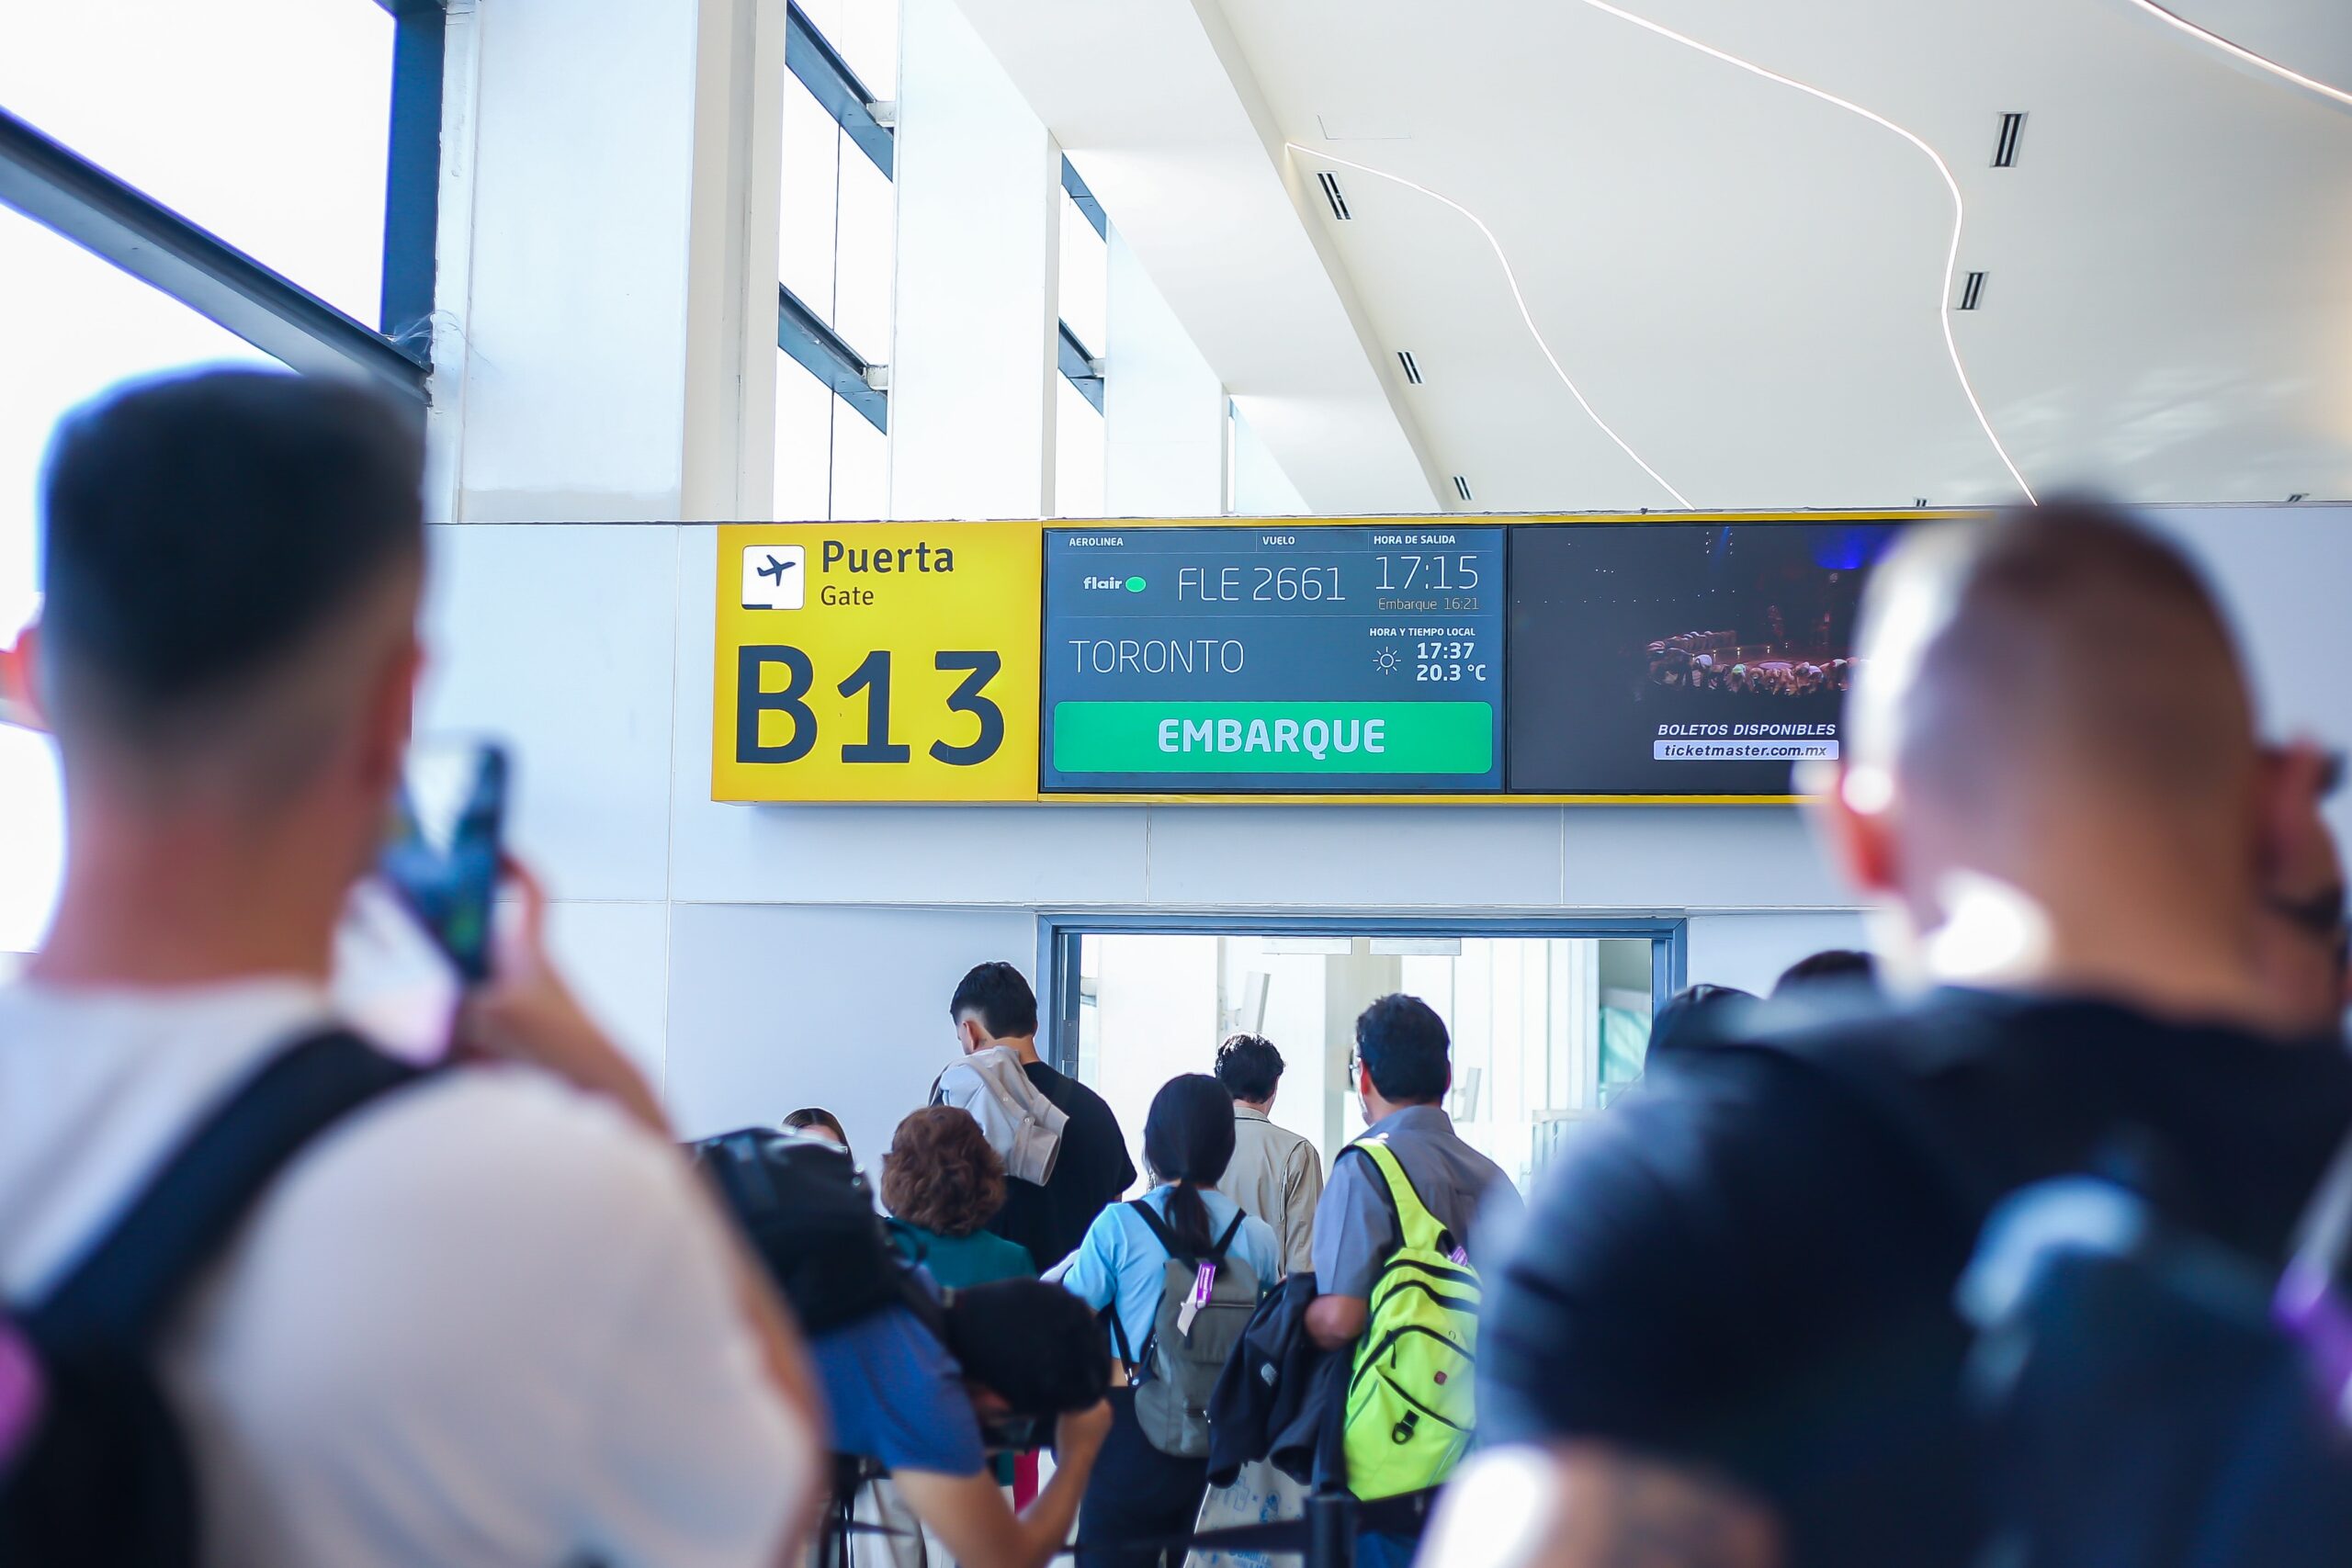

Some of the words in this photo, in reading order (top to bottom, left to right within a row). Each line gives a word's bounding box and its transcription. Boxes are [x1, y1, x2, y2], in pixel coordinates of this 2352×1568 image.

[1069, 537, 1124, 547] AEROLINEA
[1262, 536, 1295, 546] VUELO
[1374, 536, 1402, 545] HORA
[1406, 536, 1418, 544] DE
[1420, 535, 1456, 544] SALIDA
[822, 540, 954, 573] Puerta
[1375, 555, 1478, 590] 17:15
[1083, 577, 1123, 590] flair
[1179, 568, 1239, 602] FLE
[1253, 567, 1346, 601] 2661
[820, 585, 874, 606] Gate
[1378, 597, 1438, 612] Embarque
[1443, 597, 1479, 610] 16:21
[1369, 627, 1397, 637] HORA
[1399, 627, 1406, 637] Y
[1408, 627, 1444, 637] TIEMPO
[1446, 627, 1476, 637] LOCAL
[1069, 640, 1245, 673] TORONTO
[1417, 642, 1475, 660] 17:37
[1416, 664, 1462, 682] 20.3
[1467, 664, 1487, 682] °C
[736, 645, 1004, 766] B13
[1657, 724, 1728, 736] BOLETOS
[1733, 724, 1837, 736] DISPONIBLES
[1158, 718, 1385, 761] EMBARQUE
[1665, 744, 1827, 756] ticketmaster.com.mx
